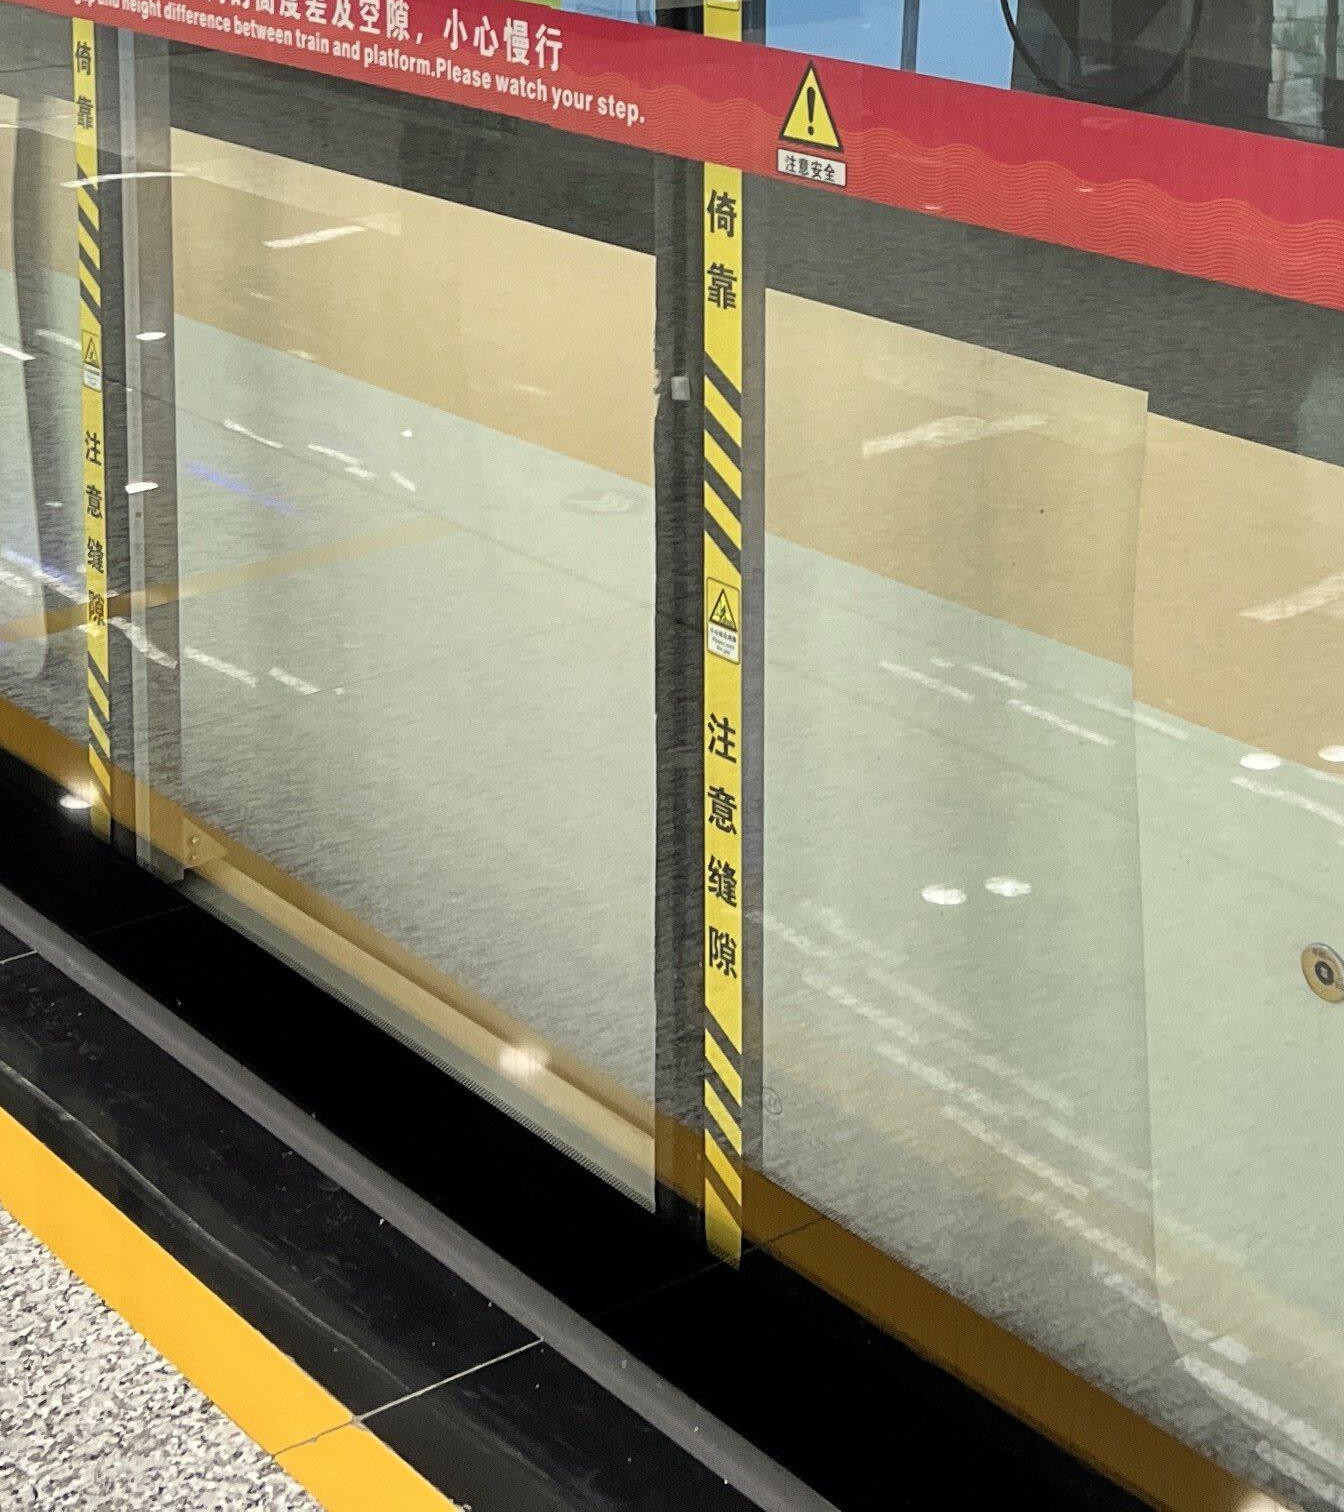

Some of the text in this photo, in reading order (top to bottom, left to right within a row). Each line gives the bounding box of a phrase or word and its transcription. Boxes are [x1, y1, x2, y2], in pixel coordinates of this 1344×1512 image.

[164, 2, 230, 32] difference
[234, 14, 292, 46] between
[296, 29, 328, 54] train
[332, 38, 360, 61] and
[496, 72, 547, 102] watch
[552, 86, 594, 110] your
[597, 94, 645, 126] step.
[784, 154, 836, 183] 注意安全
[706, 188, 738, 310] 倚靠
[707, 712, 737, 979] 注意缝隙
